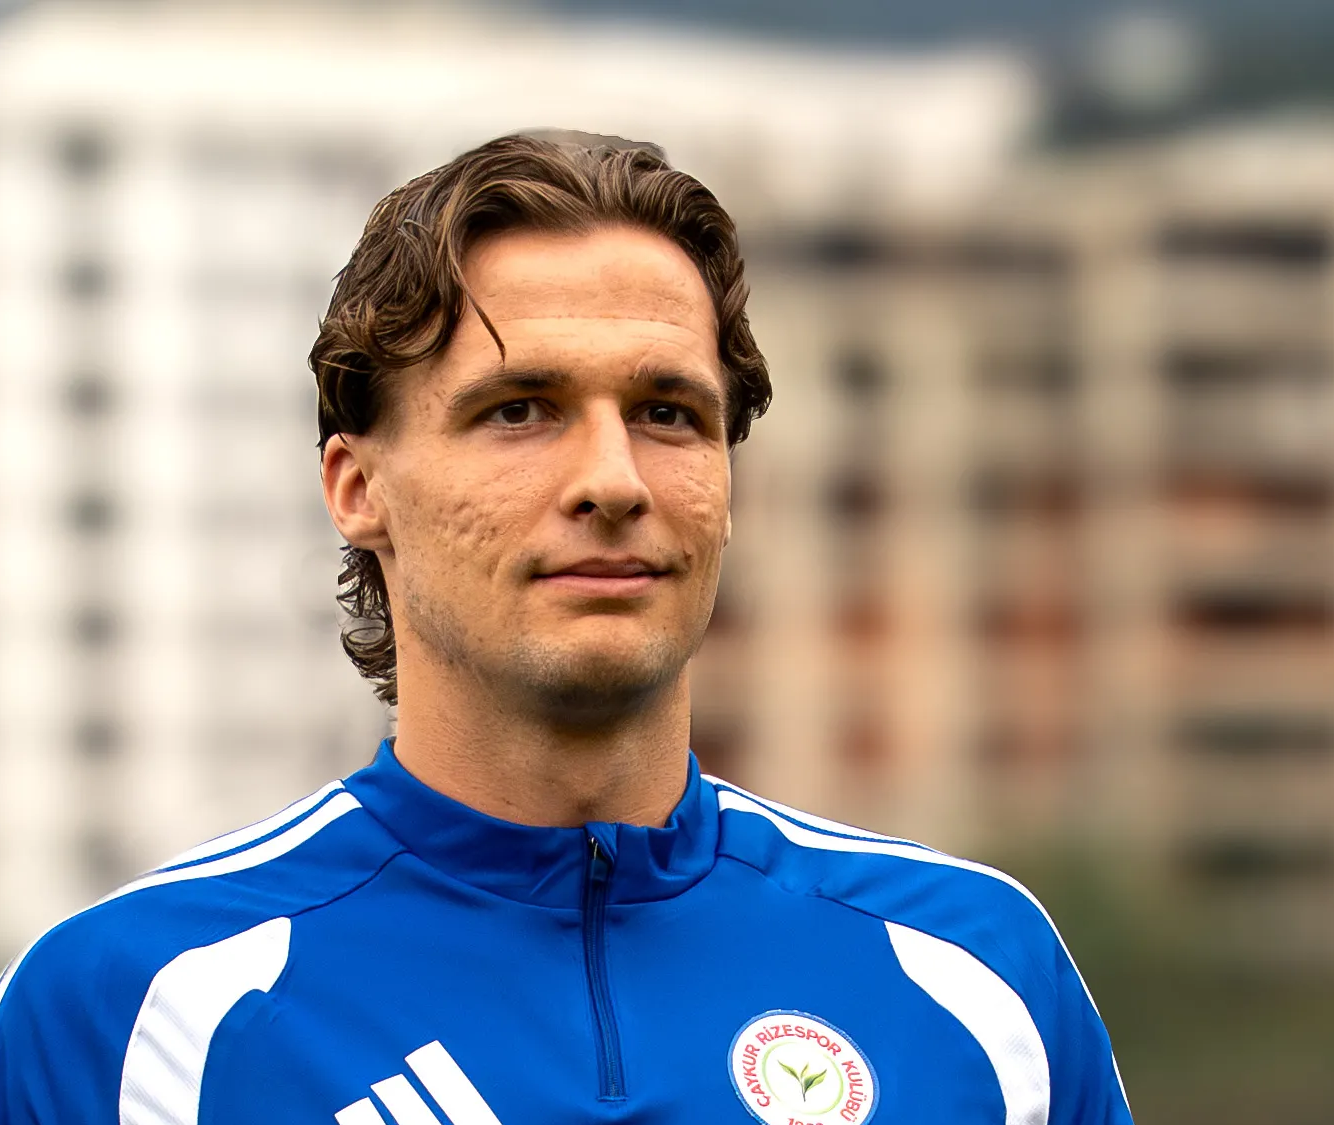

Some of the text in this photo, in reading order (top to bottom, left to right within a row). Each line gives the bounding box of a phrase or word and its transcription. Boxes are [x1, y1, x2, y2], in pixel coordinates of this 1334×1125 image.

[742, 1024, 867, 1122] ÇAYKUR RİZESPOR KULÜBÜ
